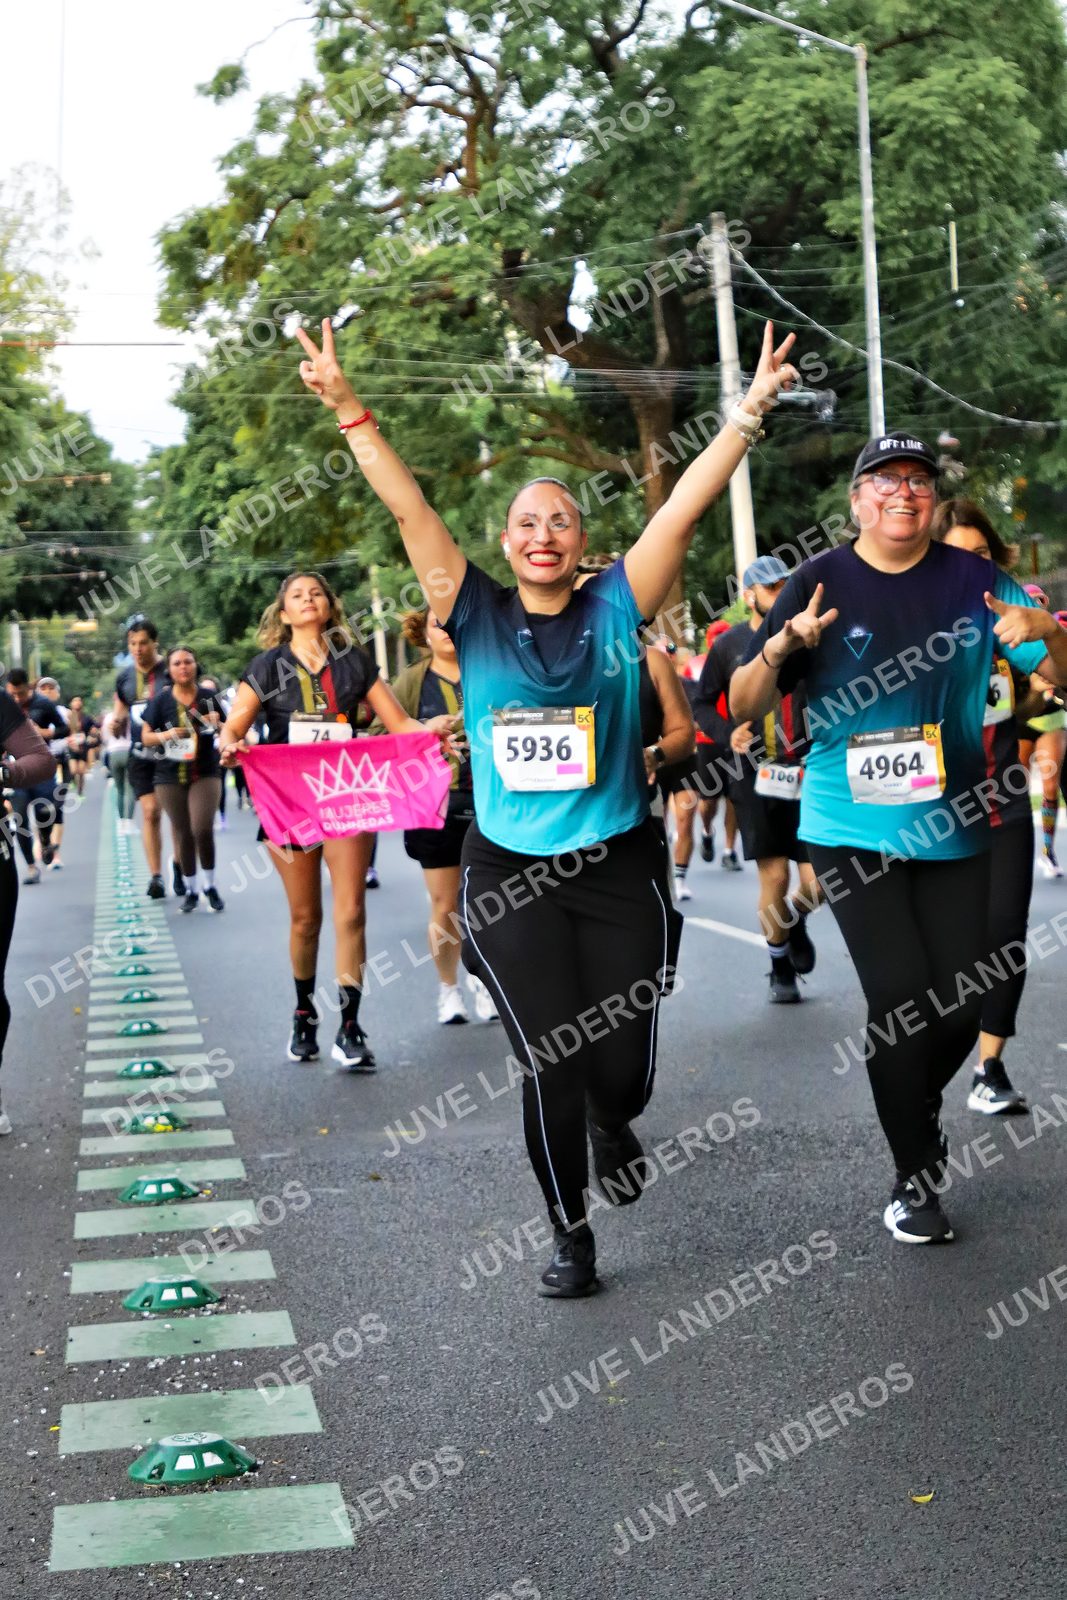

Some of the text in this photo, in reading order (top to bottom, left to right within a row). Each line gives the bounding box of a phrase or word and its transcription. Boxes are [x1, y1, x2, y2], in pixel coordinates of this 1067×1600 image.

[577, 715, 590, 723] 5K
[925, 730, 937, 739] 5K
[506, 735, 572, 762] 5936
[859, 751, 924, 780] 4964
